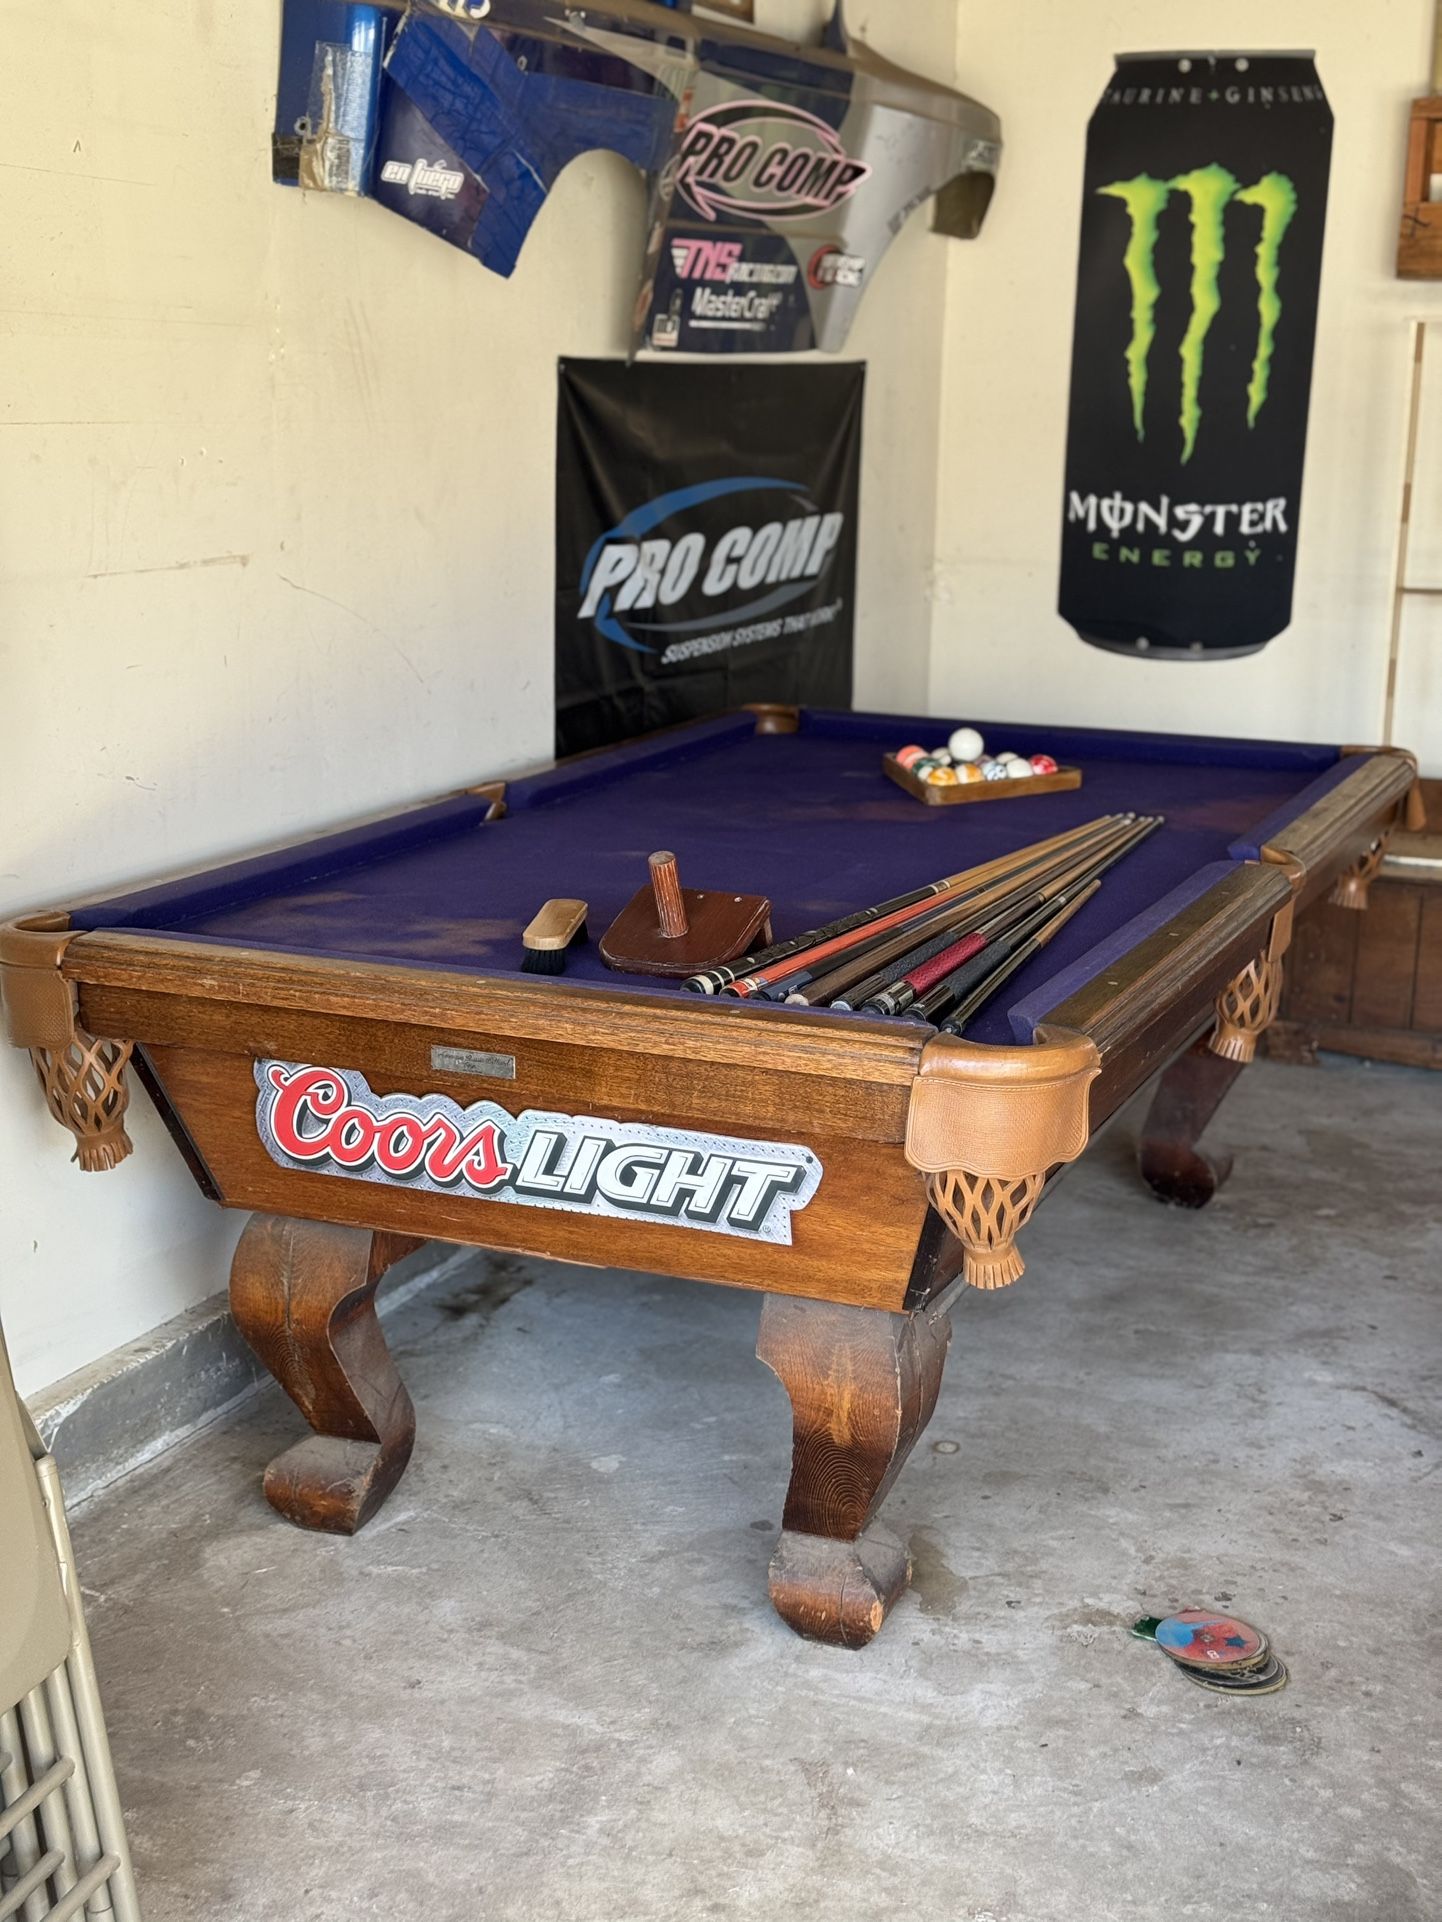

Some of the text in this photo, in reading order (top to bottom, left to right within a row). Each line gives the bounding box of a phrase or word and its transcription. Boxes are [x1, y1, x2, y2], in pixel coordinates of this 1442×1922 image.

[679, 123, 862, 207] PRO COMP
[577, 511, 844, 619] PRO COMP
[1092, 541, 1262, 568] ENERGY
[267, 1065, 808, 1233] Coors LIGHT
